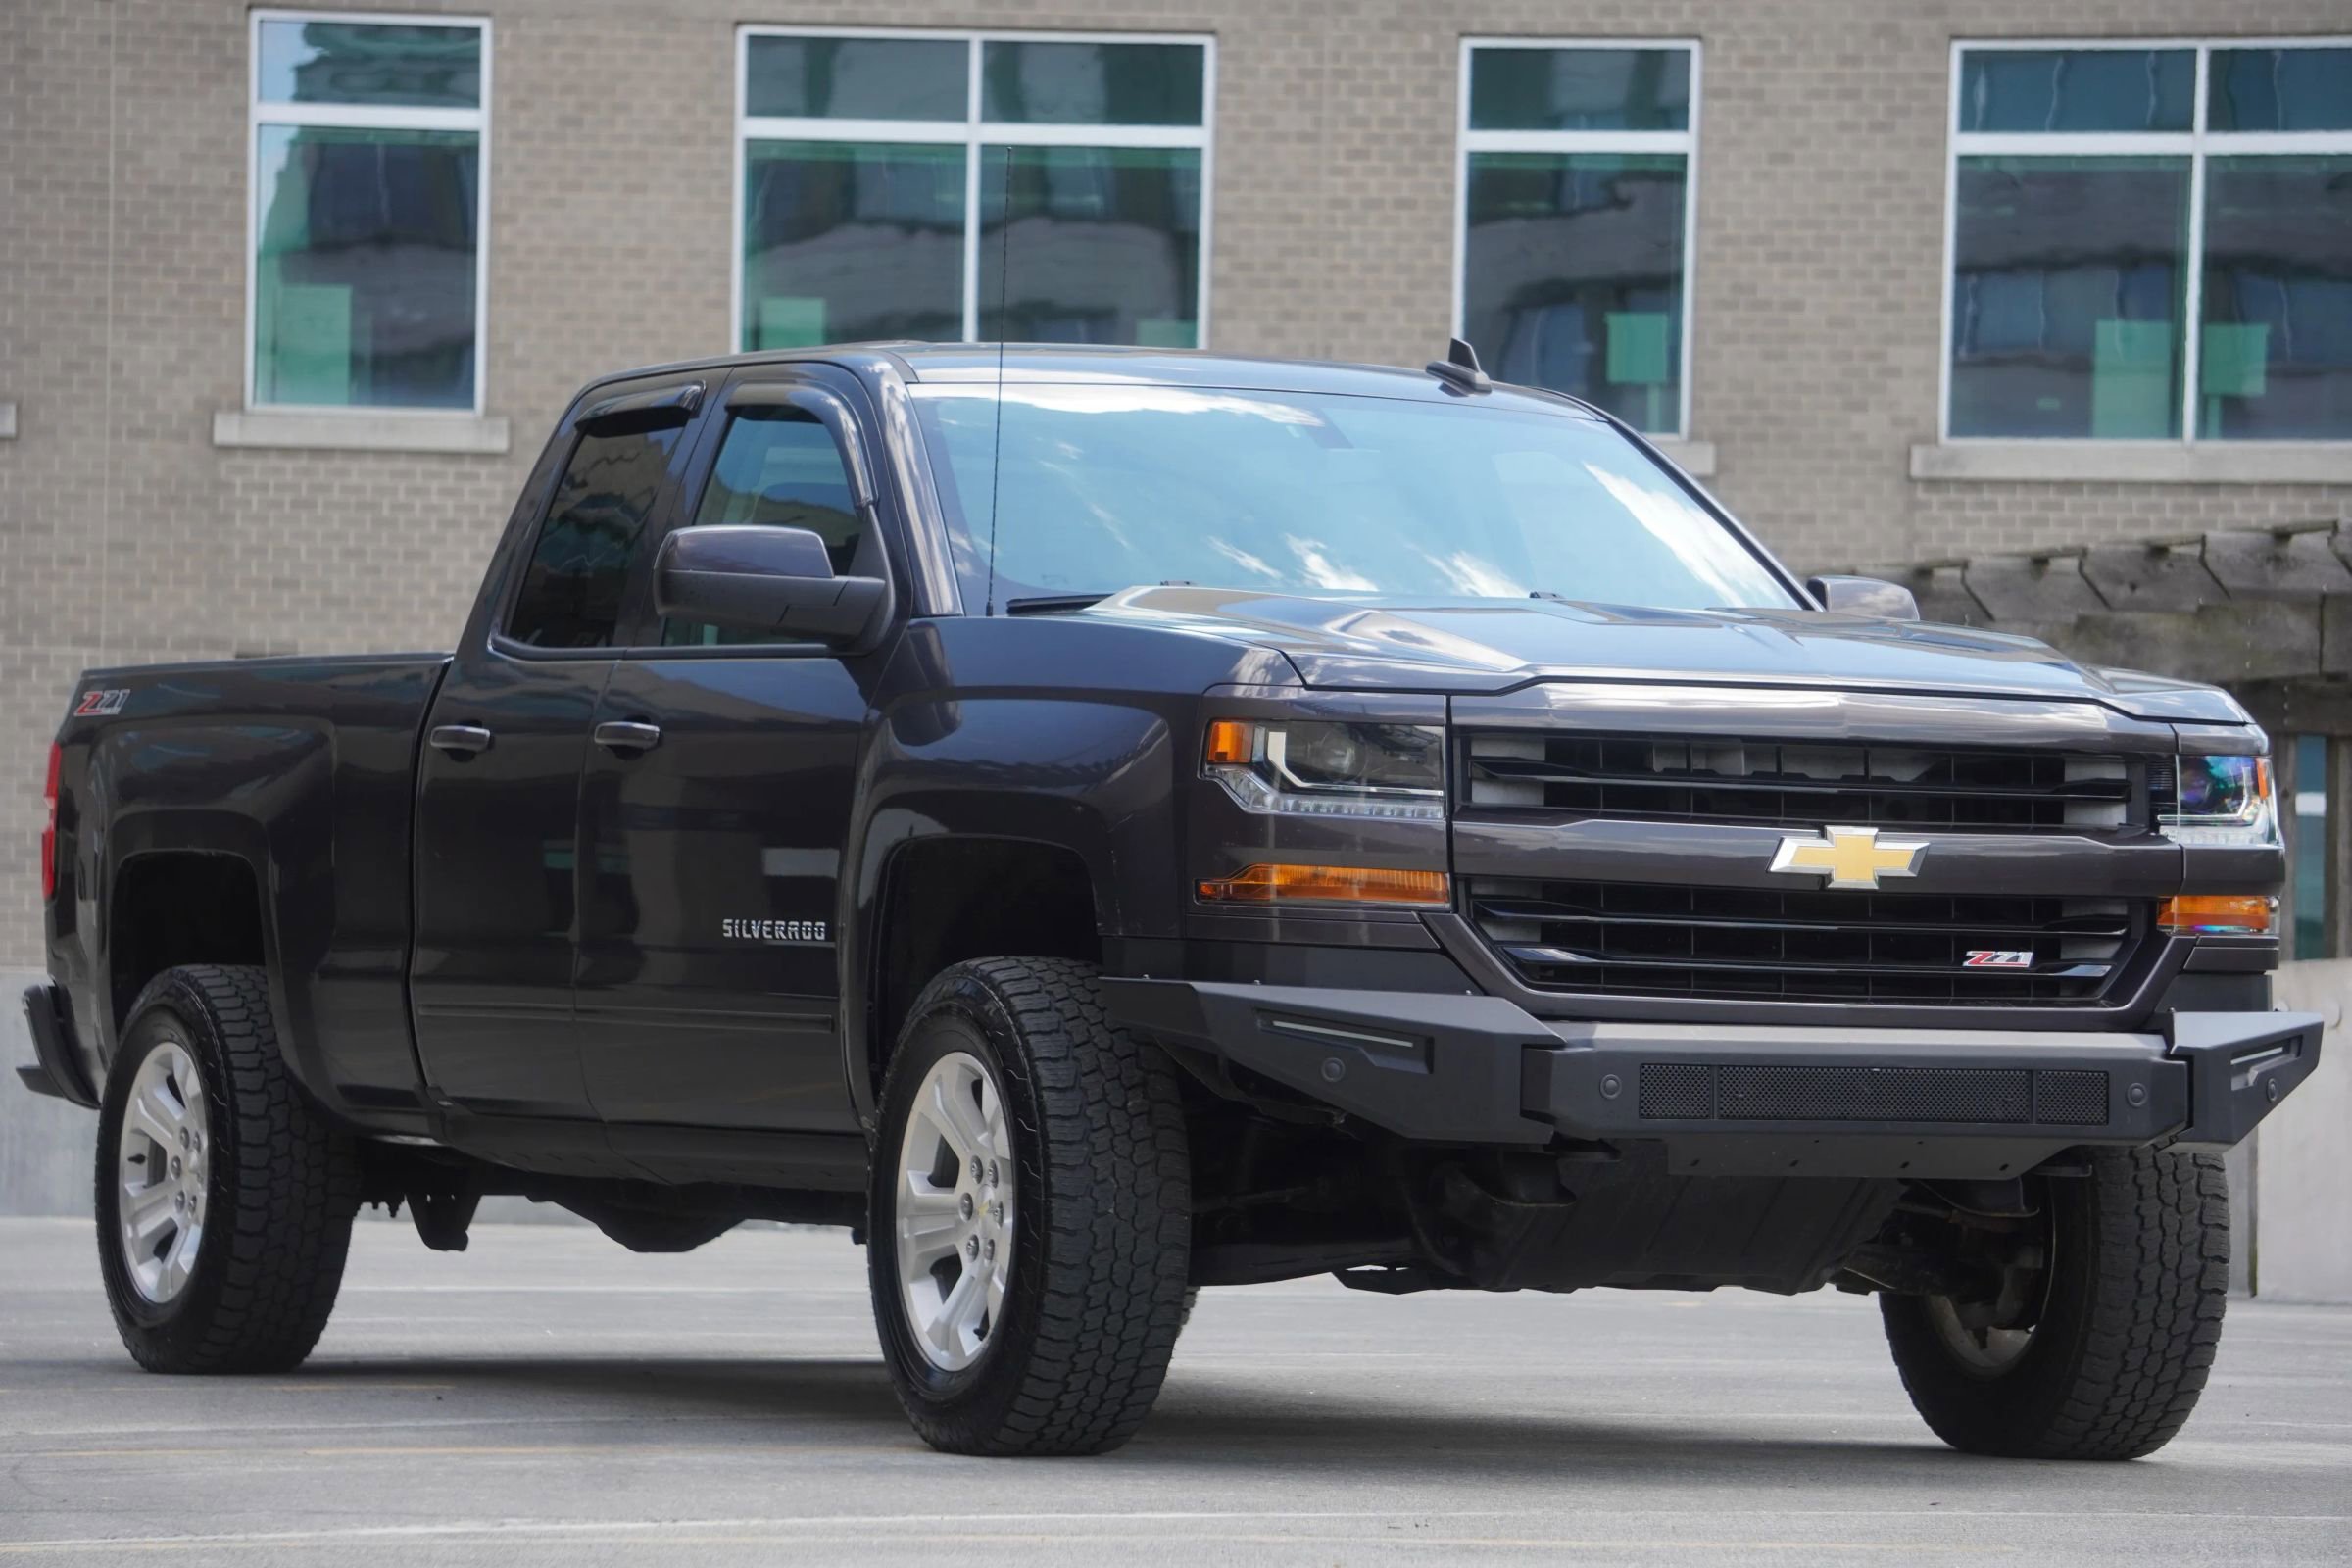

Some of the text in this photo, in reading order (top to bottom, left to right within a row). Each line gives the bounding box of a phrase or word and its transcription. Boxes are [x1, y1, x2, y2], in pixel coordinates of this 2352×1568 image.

[74, 689, 131, 717] Z71
[722, 918, 826, 941] SILVERADO
[1962, 950, 2034, 968] Z71
